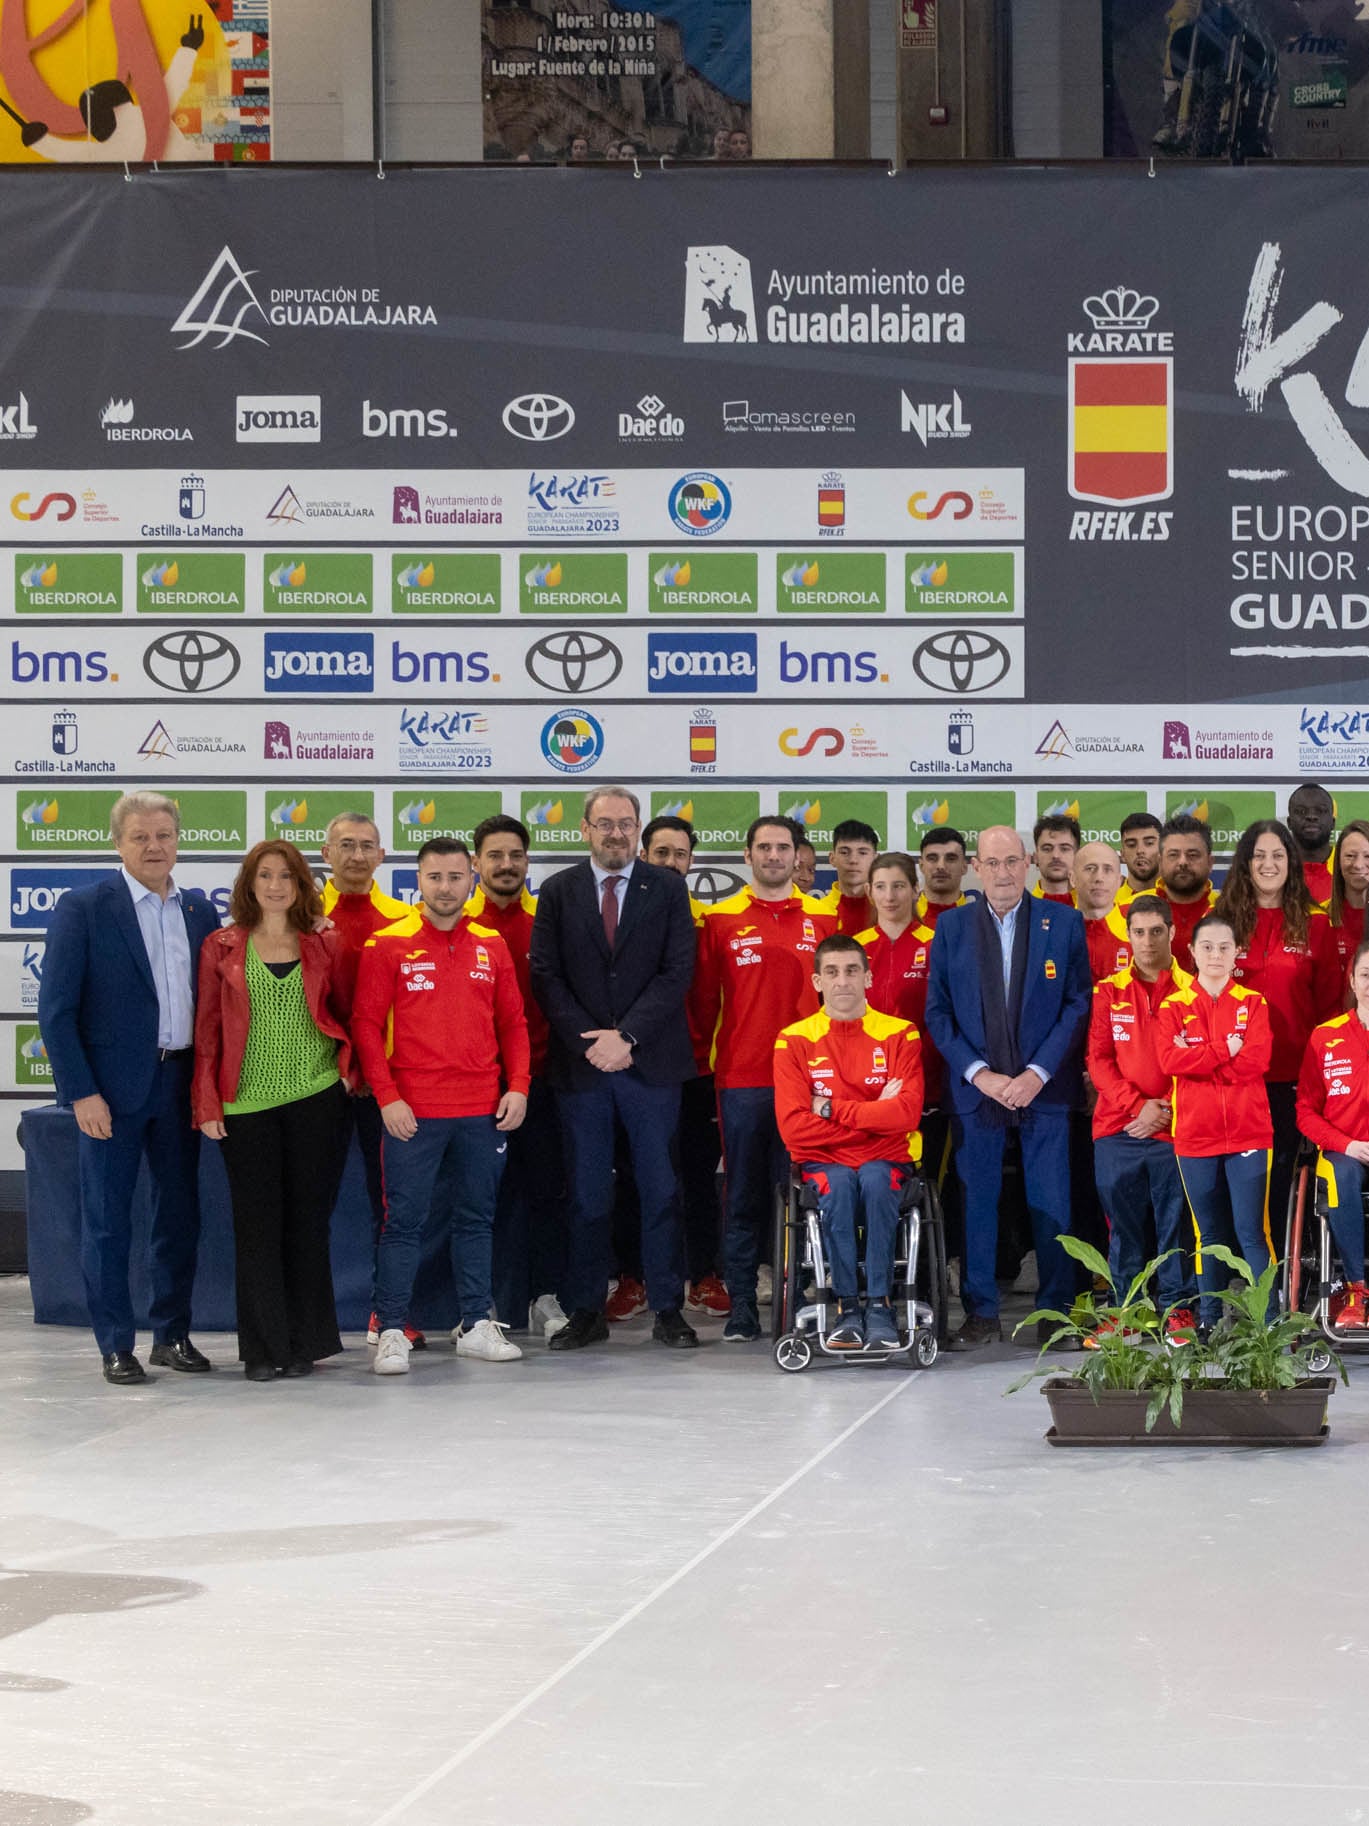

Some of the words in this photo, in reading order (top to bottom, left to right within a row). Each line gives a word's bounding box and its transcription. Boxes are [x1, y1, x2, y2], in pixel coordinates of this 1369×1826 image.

[556, 12, 594, 29] Hora:
[602, 12, 642, 28] 10:30
[645, 12, 655, 28] h
[554, 36, 607, 52] Febrero
[619, 36, 655, 52] 2015
[492, 60, 536, 78] Lugar:
[539, 60, 585, 75] Fuente
[589, 60, 606, 75] de
[609, 60, 620, 75] la
[624, 60, 656, 75] Niña
[768, 268, 929, 299] Ayuntamiento
[937, 268, 964, 295] de
[270, 285, 356, 303] DIPUTACIÓN
[361, 287, 380, 303] DE
[270, 306, 437, 325] GUADALAJARA
[767, 304, 965, 343] Guadalajara
[1068, 332, 1174, 352] KARATE
[363, 400, 457, 437] bms.
[901, 388, 971, 448] NKL
[107, 428, 193, 440] IBERDROLA
[425, 496, 488, 506] Ayuntamiento
[493, 496, 502, 506] de
[684, 498, 714, 511] WKF
[306, 509, 374, 517] GUADALAJARA
[425, 509, 502, 524] Guadalajara
[202, 525, 243, 536] Mancha
[587, 520, 619, 531] 2023
[1069, 512, 1173, 540] RFEK.ES
[1232, 551, 1356, 580] SENIOR
[30, 592, 117, 604] IBERDROLA
[151, 592, 239, 604] IBERDROLA
[278, 592, 367, 604] IBERDROLA
[407, 593, 495, 605] IBERDROLA
[534, 592, 622, 605] IBERDROLA
[664, 592, 752, 604] IBERDROLA
[792, 592, 880, 604] IBERDROLA
[920, 592, 1008, 604] IBERDROLA
[12, 641, 118, 682] bms.
[392, 641, 500, 682] bms.
[780, 641, 888, 683] bms.
[296, 731, 360, 743] Ayuntamiento
[362, 731, 374, 741] de
[557, 734, 587, 748] WKF
[1195, 730, 1259, 741] Ayuntamiento
[1262, 730, 1273, 741] de
[177, 744, 246, 752] GUADALAJARA
[297, 744, 373, 759] Guadalajara
[1074, 744, 1144, 752] GUADALAJARA
[1196, 744, 1273, 759] Guadalajara
[75, 760, 115, 772] Mancha
[457, 756, 491, 767] 2023
[971, 761, 1012, 772] Mancha
